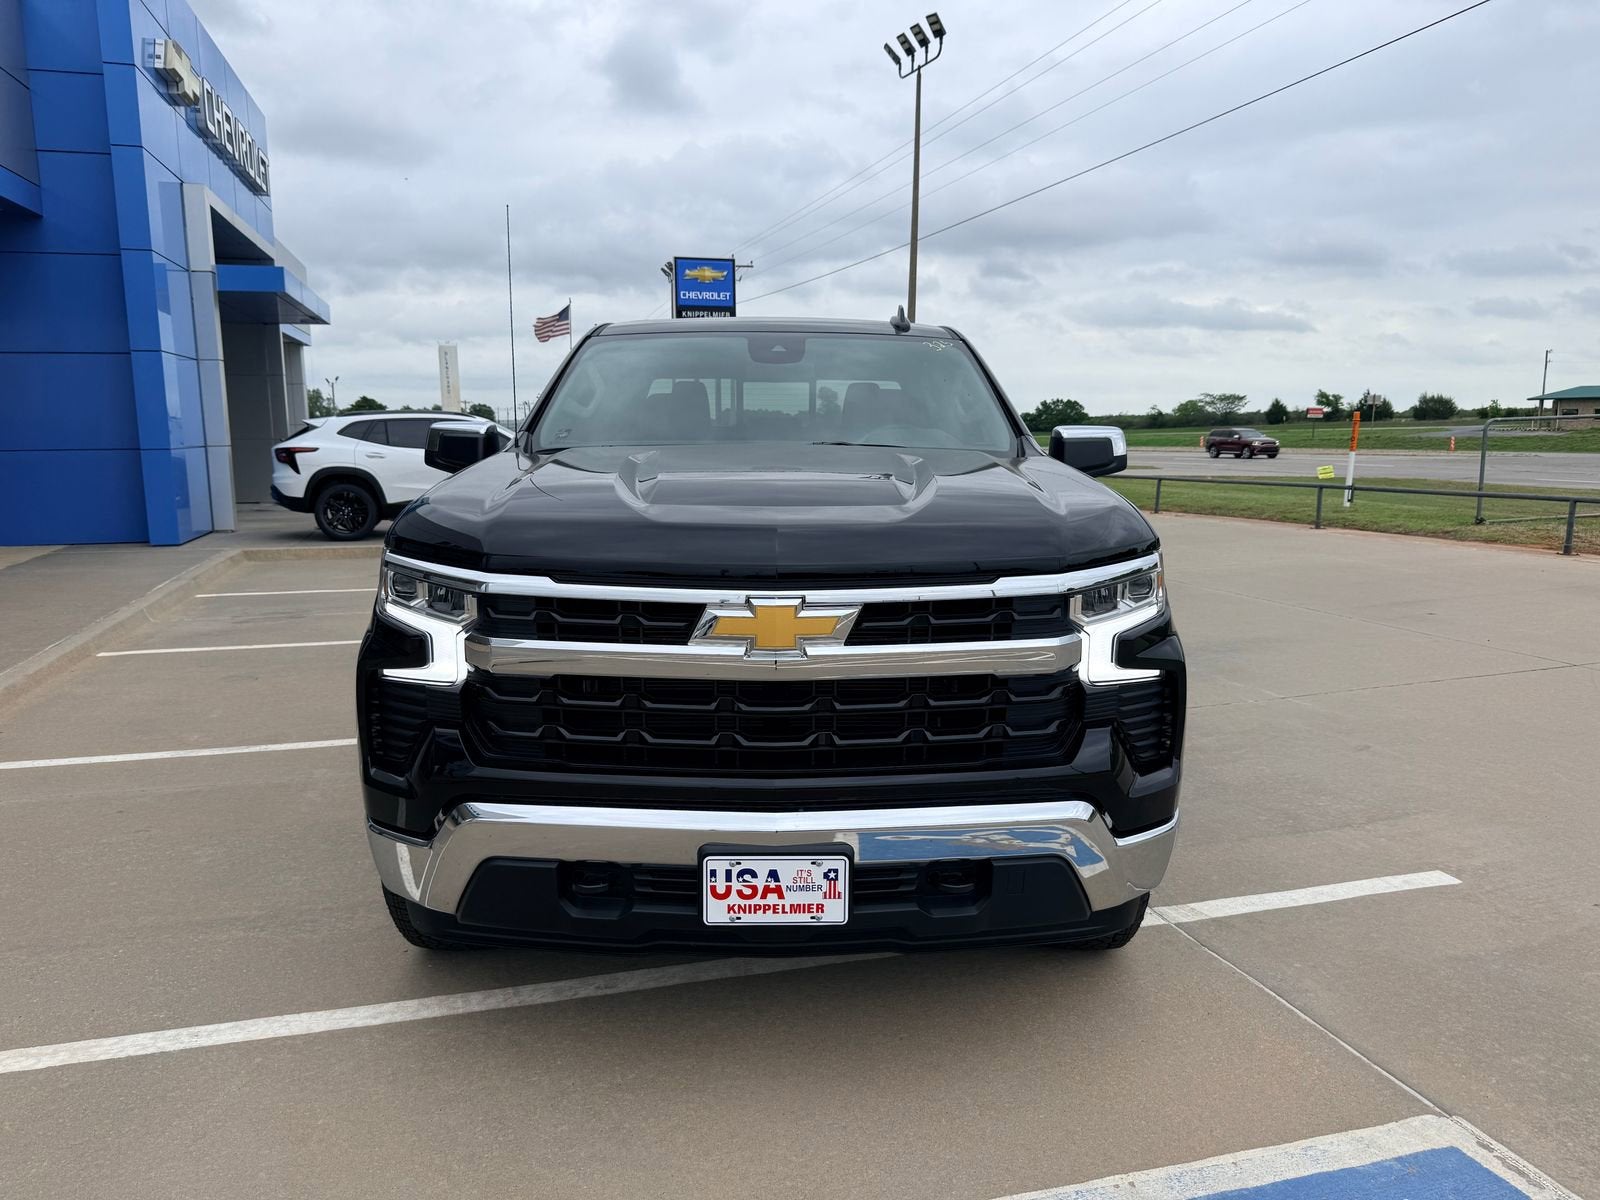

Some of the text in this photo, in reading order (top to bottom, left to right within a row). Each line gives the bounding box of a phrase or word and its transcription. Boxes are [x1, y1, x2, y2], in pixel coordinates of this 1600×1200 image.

[200, 77, 269, 194] CHEVROLET
[680, 290, 731, 300] CHEVROLET
[681, 310, 731, 318] KNIPPELMIER
[796, 869, 812, 877] IT'S
[709, 868, 786, 900] USA
[785, 884, 823, 892] NUMBER
[727, 903, 825, 914] KNIPPELMIER
